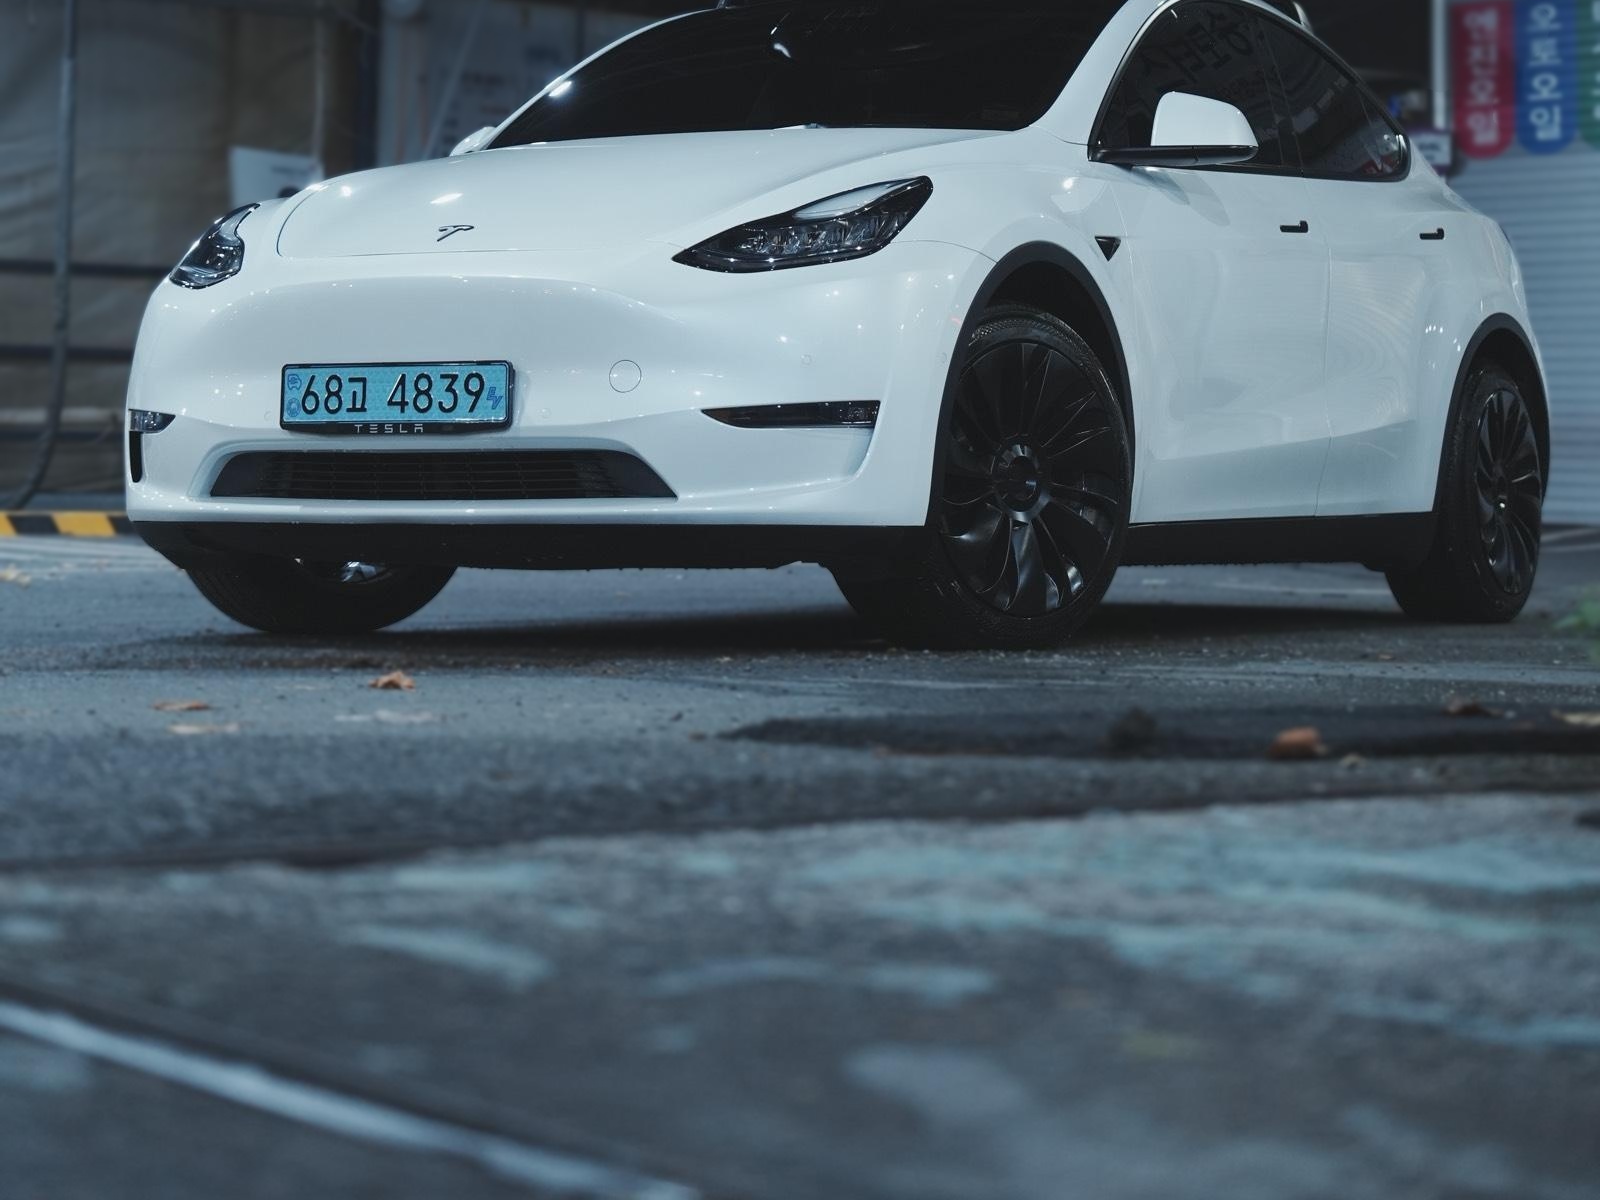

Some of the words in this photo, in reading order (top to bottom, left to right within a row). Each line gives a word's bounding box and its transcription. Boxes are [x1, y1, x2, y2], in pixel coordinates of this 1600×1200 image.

[301, 374, 368, 415] 68고
[386, 372, 485, 414] 4839
[354, 423, 424, 434] TESLA
